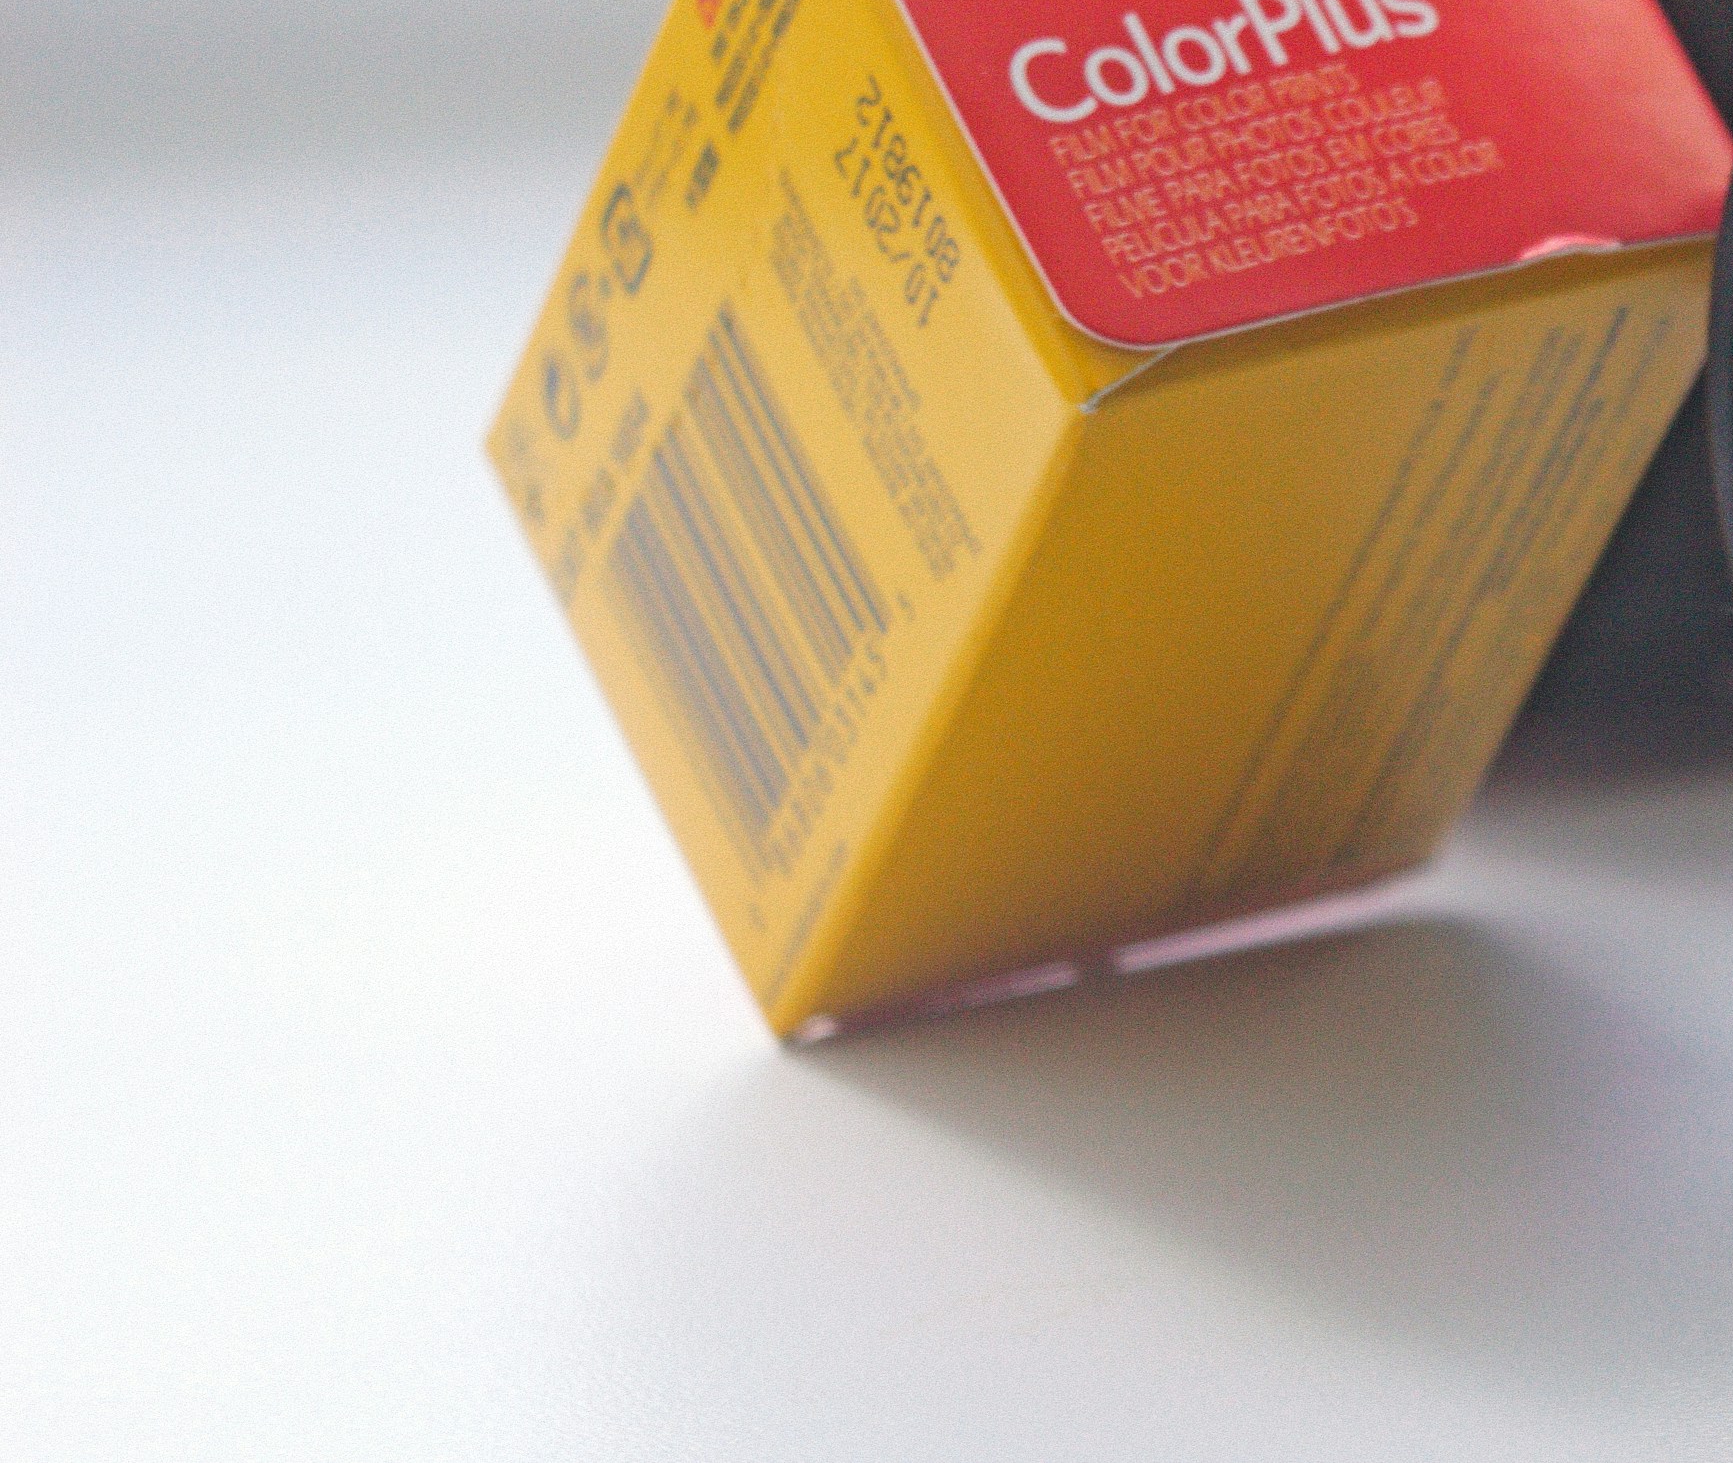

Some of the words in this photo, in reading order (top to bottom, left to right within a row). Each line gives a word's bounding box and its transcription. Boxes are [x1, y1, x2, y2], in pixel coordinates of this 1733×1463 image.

[1049, 124, 1118, 168] FILM
[1114, 108, 1176, 148] FOR
[1175, 83, 1273, 131] COLOR
[1066, 157, 1134, 199] FILM
[1131, 136, 1214, 179] POUR
[1209, 107, 1324, 158] PHOTOS
[1322, 76, 1450, 132] COULEUR
[1084, 186, 1168, 233] FILME
[1164, 168, 1239, 211] PARA
[1233, 143, 1328, 191] FOTOS
[1325, 133, 1374, 168] EM
[1372, 113, 1460, 158] CORES
[1223, 191, 1299, 231] PARA
[1293, 166, 1388, 214] FOTOS
[1387, 160, 1415, 191] A
[1410, 137, 1505, 185] COLOR
[1117, 251, 1211, 300] VOOR
